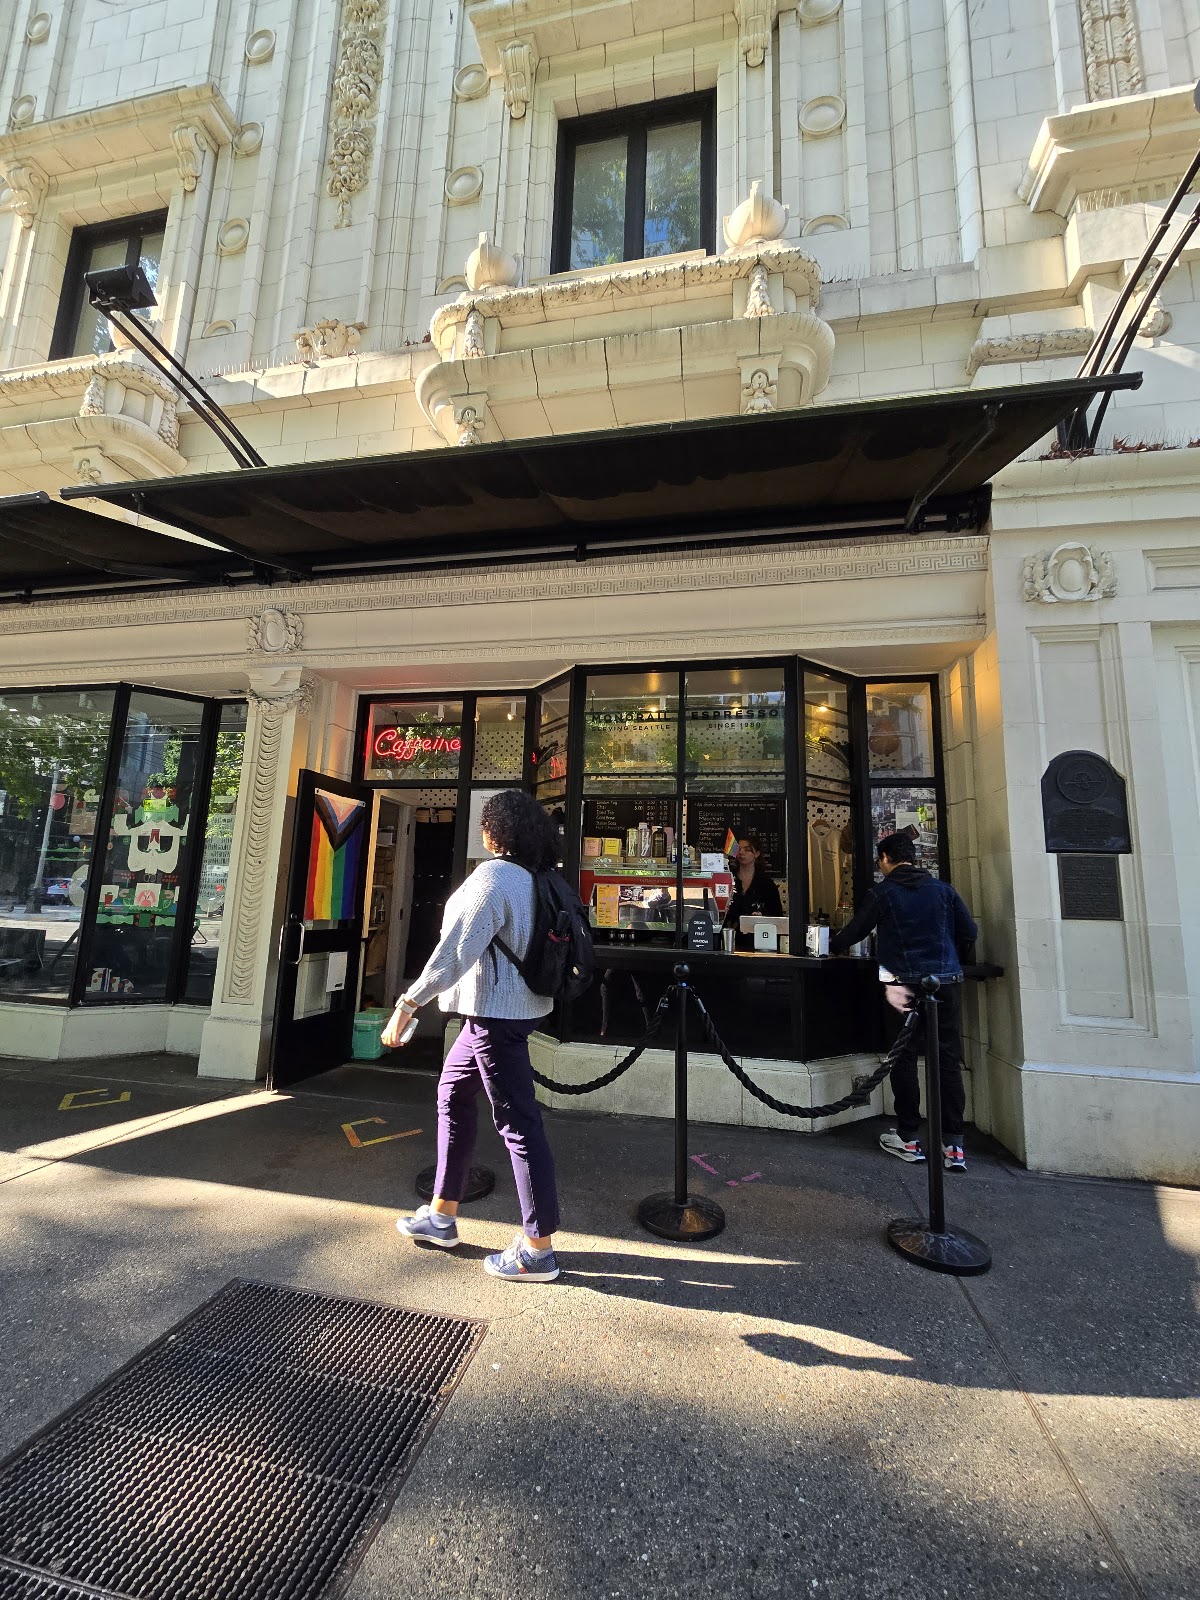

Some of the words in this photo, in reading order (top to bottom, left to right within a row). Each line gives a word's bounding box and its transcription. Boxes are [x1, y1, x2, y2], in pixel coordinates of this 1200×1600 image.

[592, 712, 671, 722] MONORAIL
[691, 709, 780, 720] ESPRESSO
[740, 722, 762, 730] 1980
[375, 729, 462, 760] Caffeine
